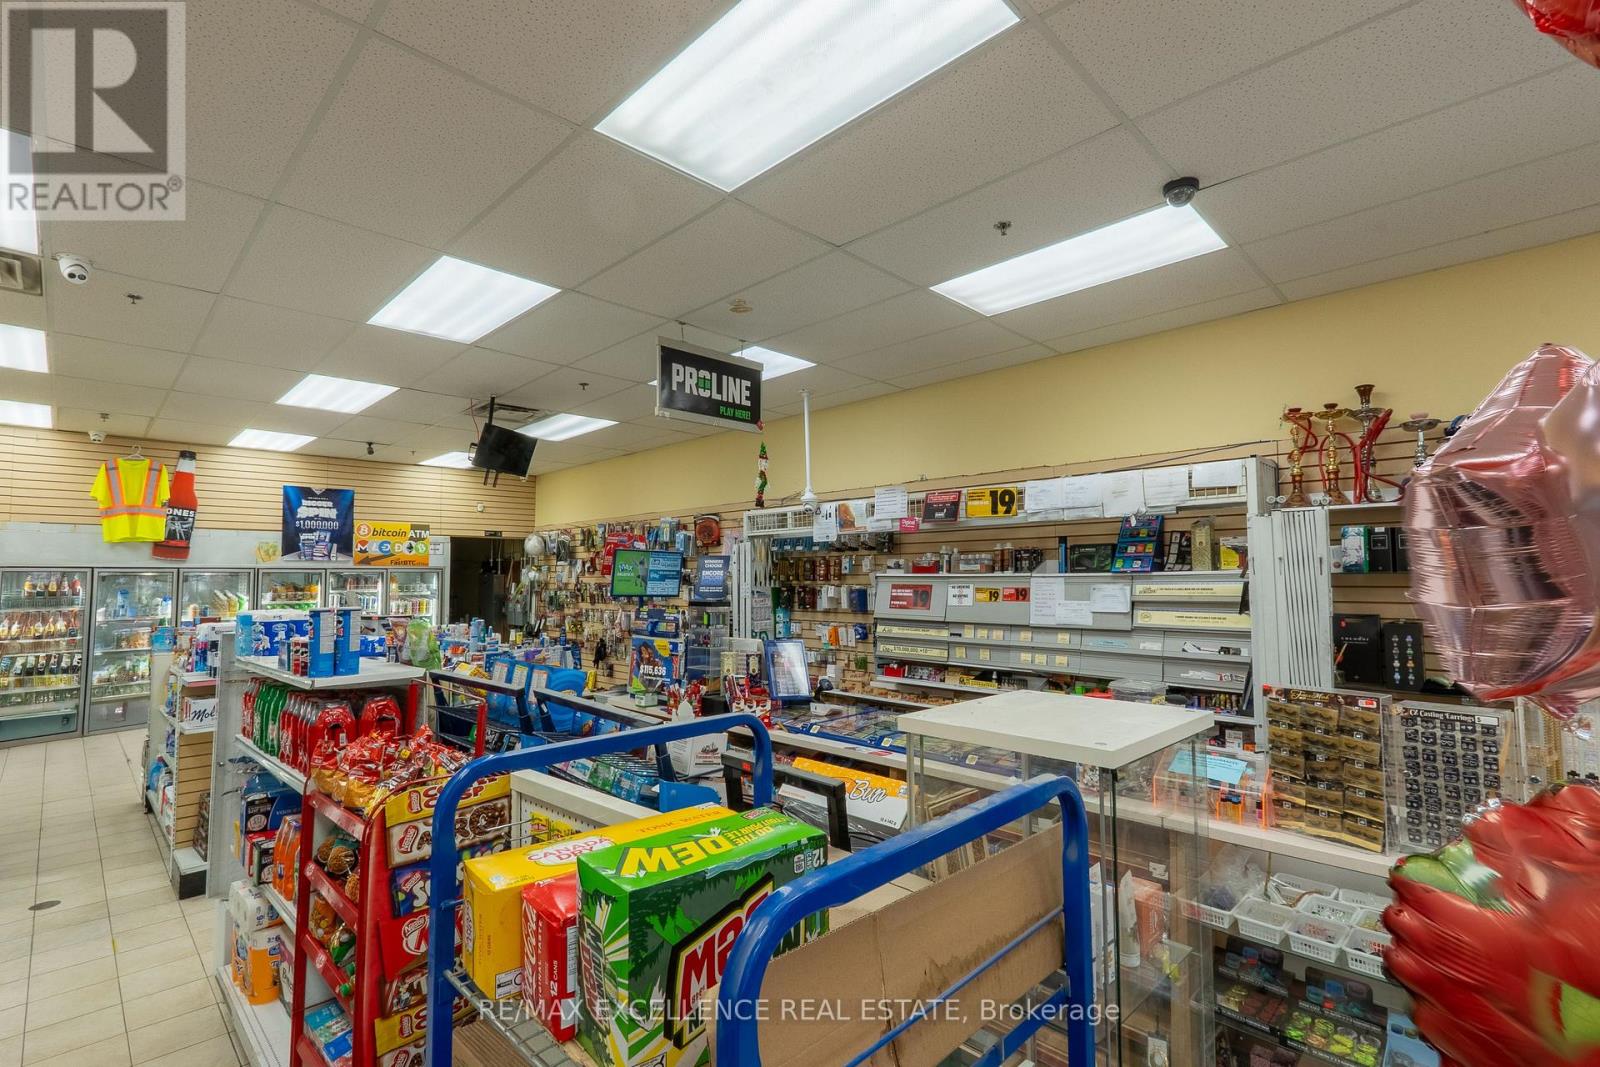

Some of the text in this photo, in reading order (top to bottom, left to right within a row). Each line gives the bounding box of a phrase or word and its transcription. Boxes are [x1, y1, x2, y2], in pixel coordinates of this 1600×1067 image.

[671, 362, 752, 407] PROLINE
[720, 405, 751, 420] PLAY HERE!
[989, 488, 1016, 515] 19
[166, 506, 196, 517] ONES
[371, 527, 430, 539] bitcoin ATM
[913, 590, 929, 607] 19
[989, 591, 1000, 602] 19
[1014, 587, 1028, 600] 19
[849, 779, 888, 804] Bun
[639, 809, 721, 834] TONIC WATER
[723, 830, 740, 840] LE
[733, 825, 773, 846] DO THE
[527, 836, 612, 862] CANADA
[557, 845, 595, 861] DRY
[812, 847, 825, 867] 12
[620, 839, 733, 877] DEW
[550, 980, 558, 997] 12
